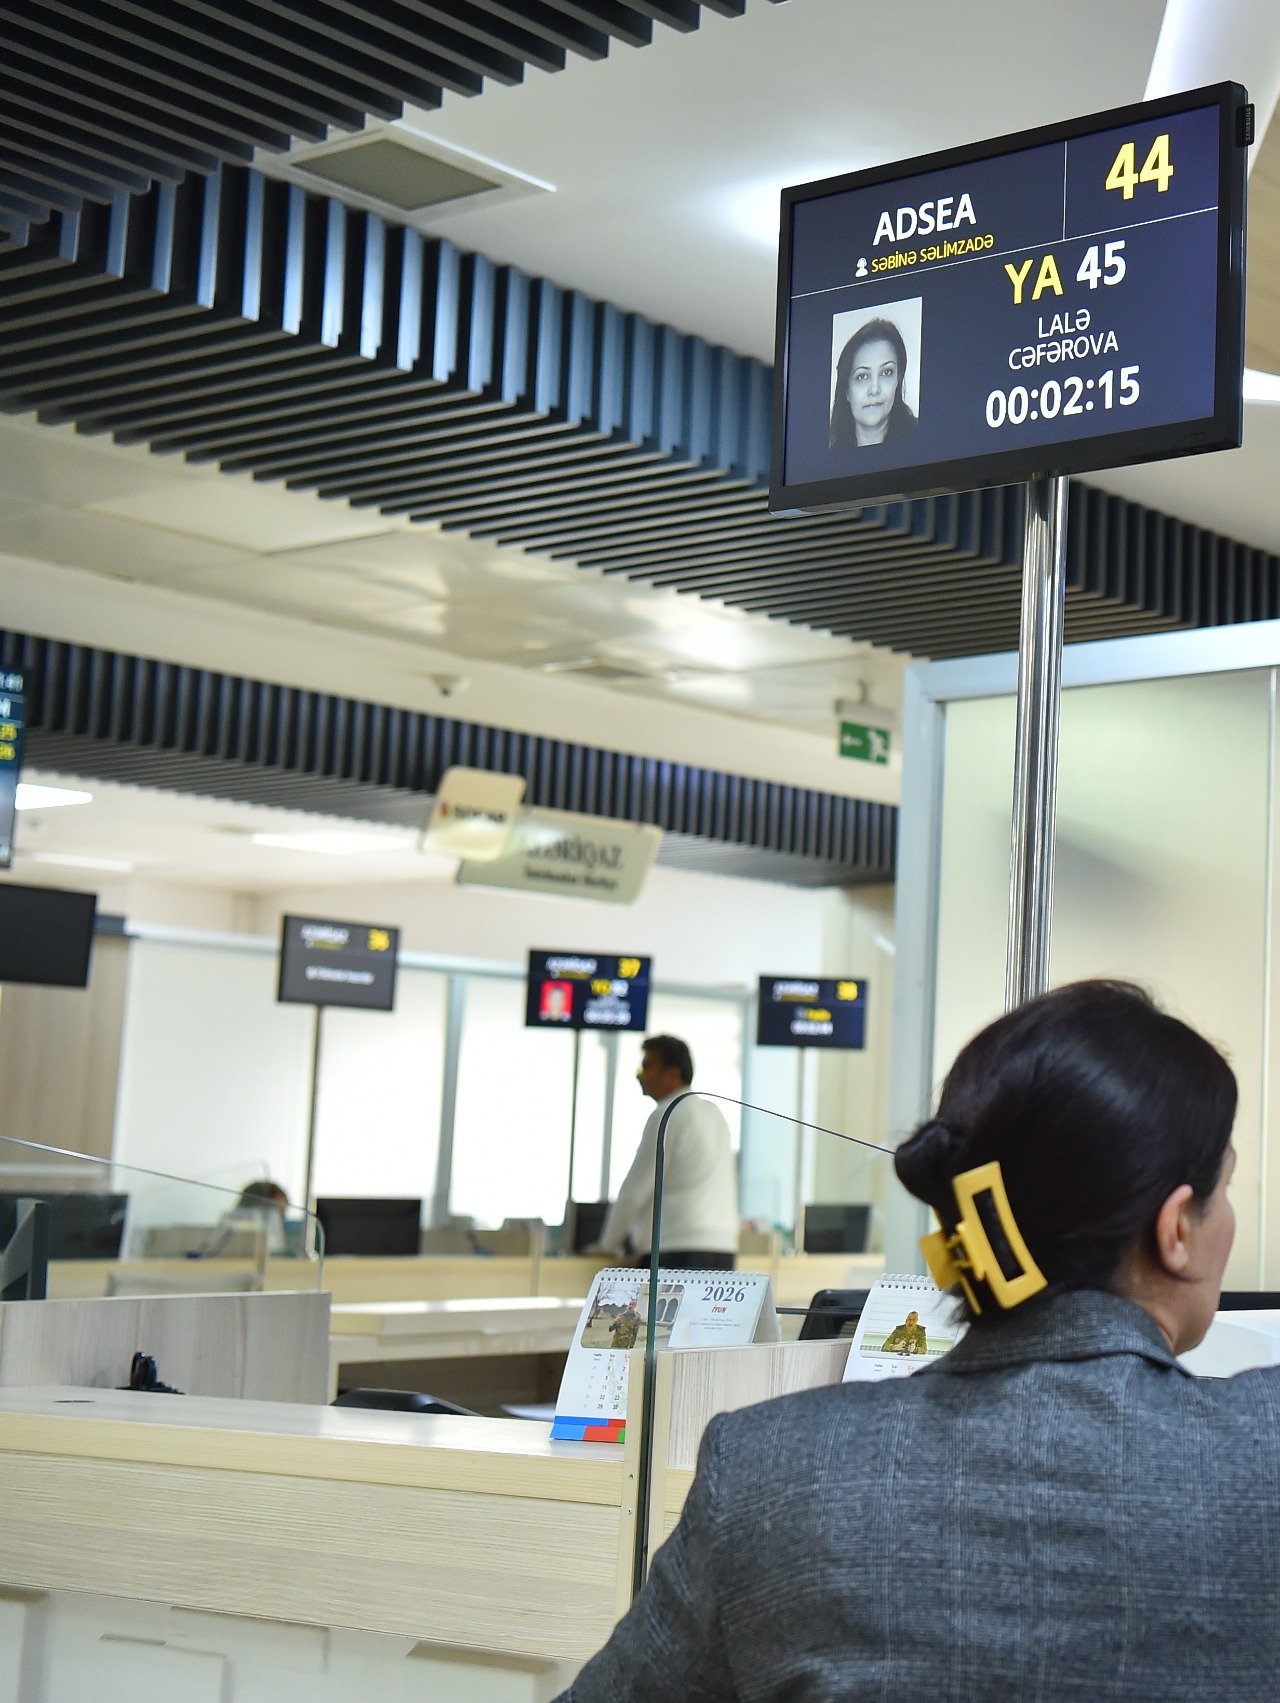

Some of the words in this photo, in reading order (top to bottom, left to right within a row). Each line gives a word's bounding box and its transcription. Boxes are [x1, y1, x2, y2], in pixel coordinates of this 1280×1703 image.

[1105, 134, 1173, 199] 44
[872, 193, 976, 245] ADSEA
[871, 248, 917, 273] SƏBİNƏ
[919, 234, 994, 263] SƏLİMZADƏ
[1004, 255, 1064, 304] YA
[1076, 240, 1127, 290] 45
[1038, 309, 1091, 338] LALƏ
[1008, 330, 1119, 370] CƏFƏROVA
[985, 365, 1140, 428] 00:02:15
[701, 1286, 746, 1303] 2026
